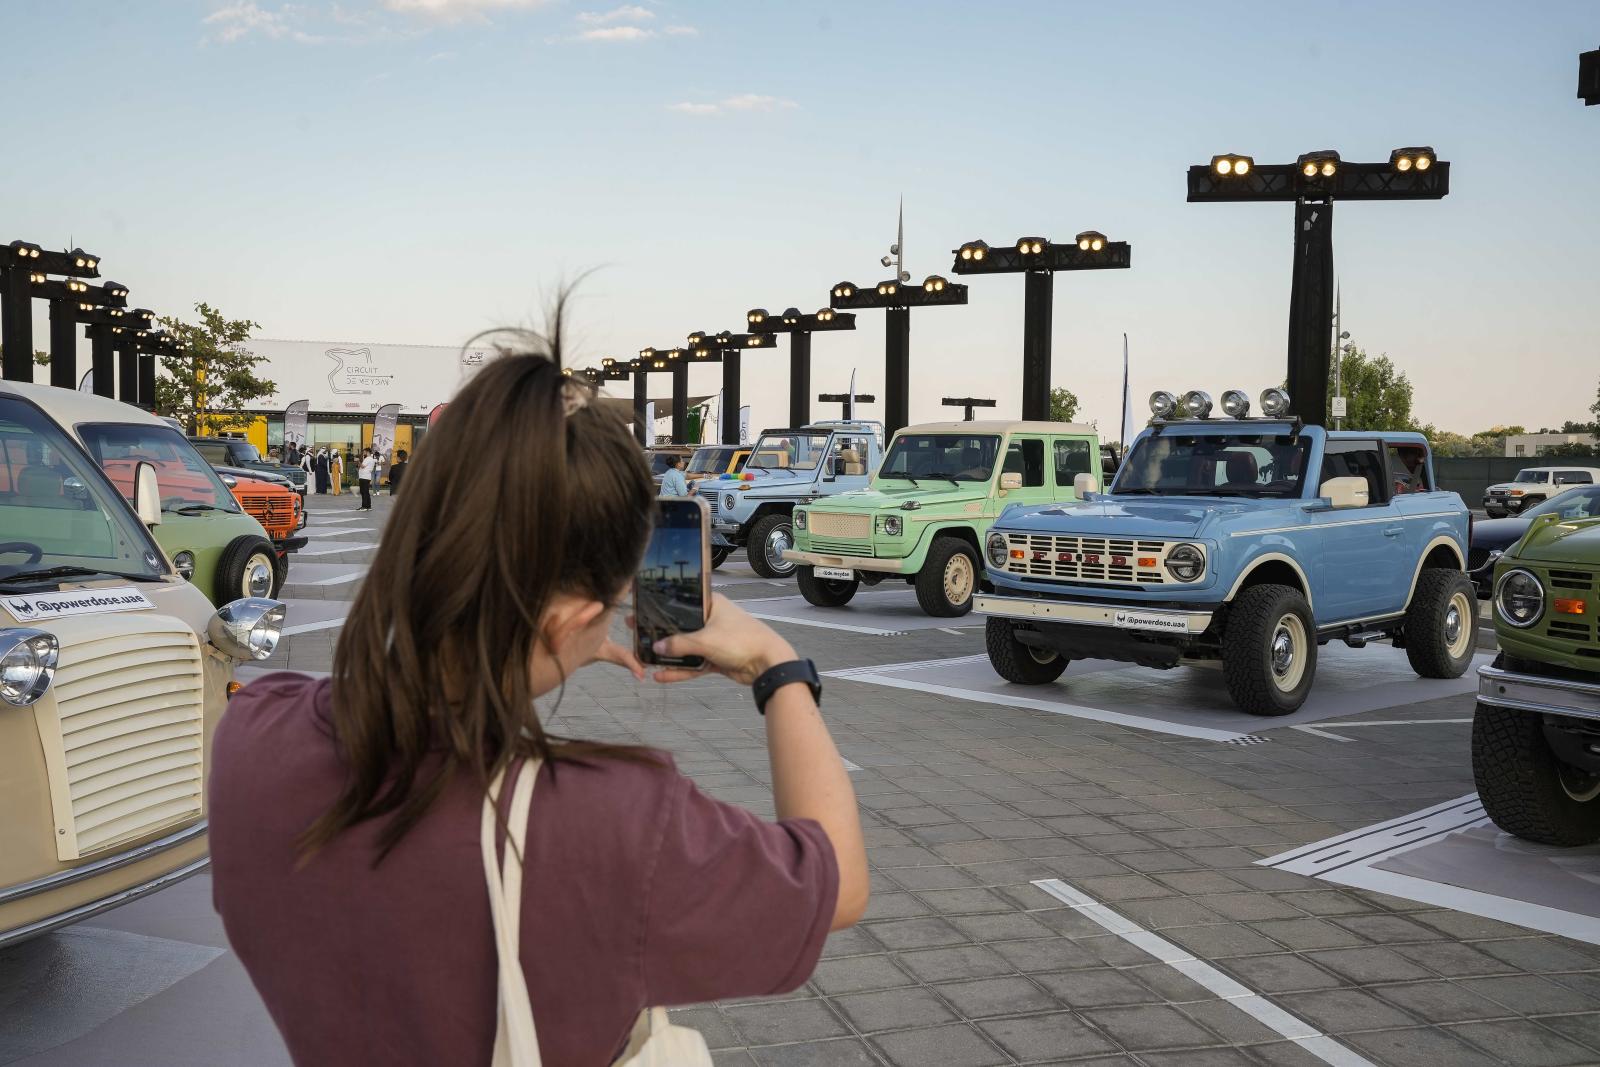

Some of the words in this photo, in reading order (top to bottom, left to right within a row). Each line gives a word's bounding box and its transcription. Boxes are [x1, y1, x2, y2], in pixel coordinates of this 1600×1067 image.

[1032, 551, 1127, 567] FORD
[35, 594, 145, 613] @powerdose.uae
[1126, 616, 1186, 629] @powerdose.uae
